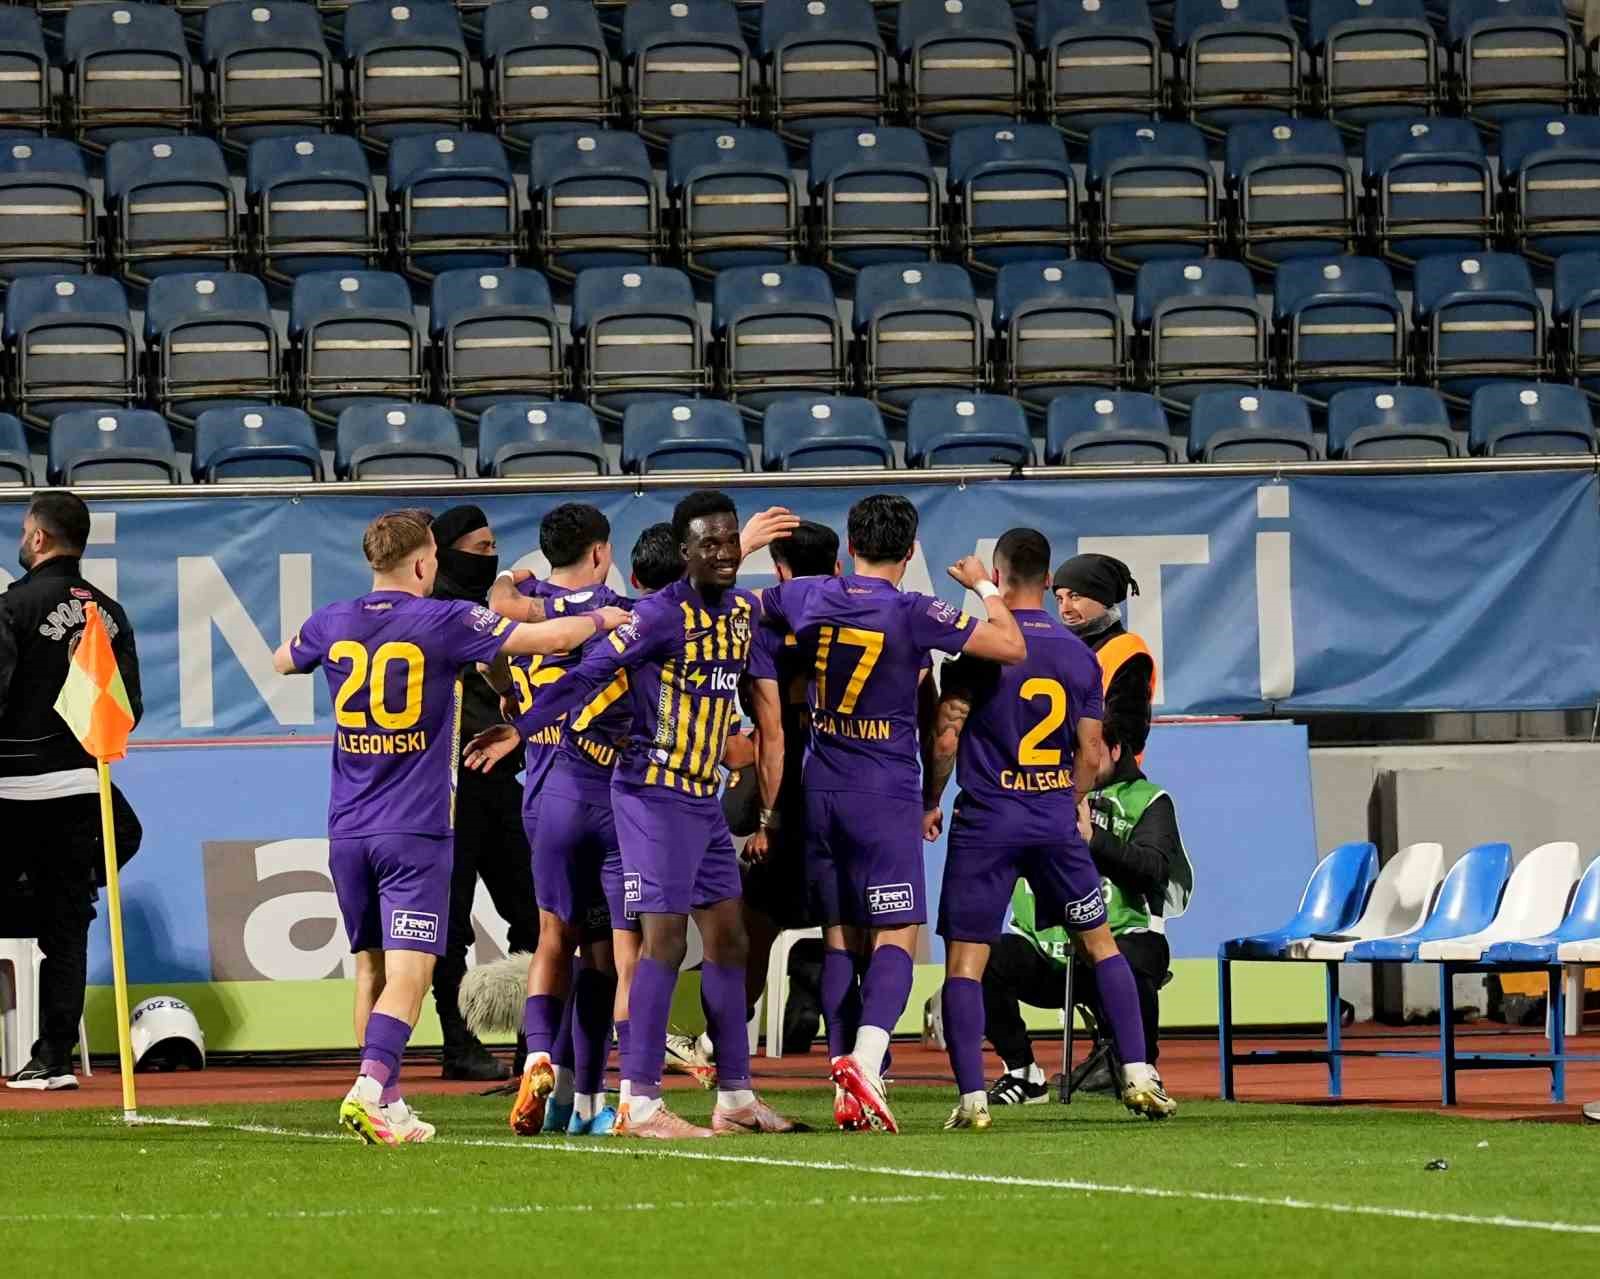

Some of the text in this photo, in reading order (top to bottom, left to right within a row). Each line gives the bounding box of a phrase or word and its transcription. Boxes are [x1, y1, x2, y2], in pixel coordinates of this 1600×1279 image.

[328, 640, 424, 729] 20
[814, 626, 884, 714] 17
[337, 731, 427, 754] LEGOWSKI
[1018, 677, 1067, 766] 2
